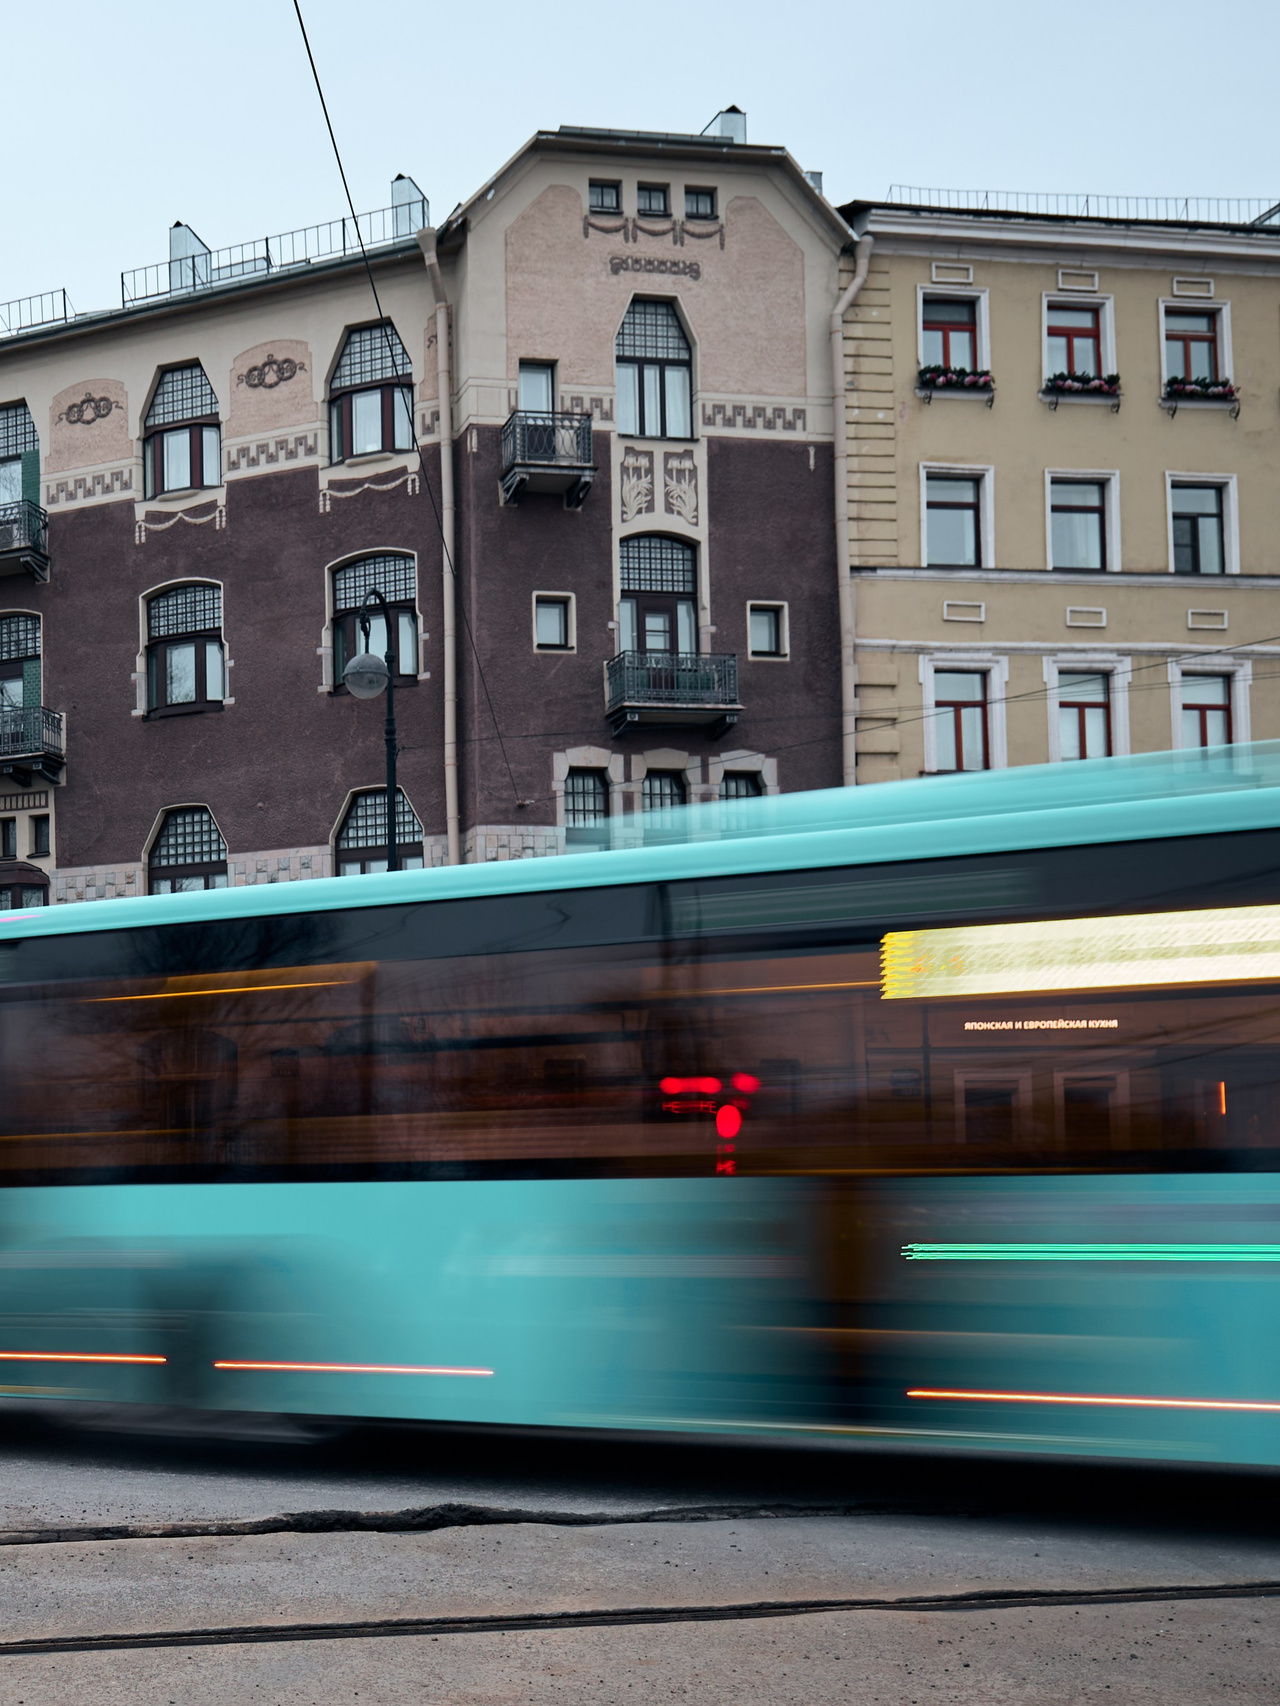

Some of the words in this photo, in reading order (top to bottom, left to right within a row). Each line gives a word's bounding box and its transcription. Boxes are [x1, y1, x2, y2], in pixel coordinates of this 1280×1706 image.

[964, 1021, 1014, 1030] ЯПОНСКАЯ
[1015, 1021, 1022, 1030] И
[1023, 1019, 1087, 1030] ЕВРОПЕЙСКАЯ
[1088, 1019, 1119, 1029] КУХНЯ
